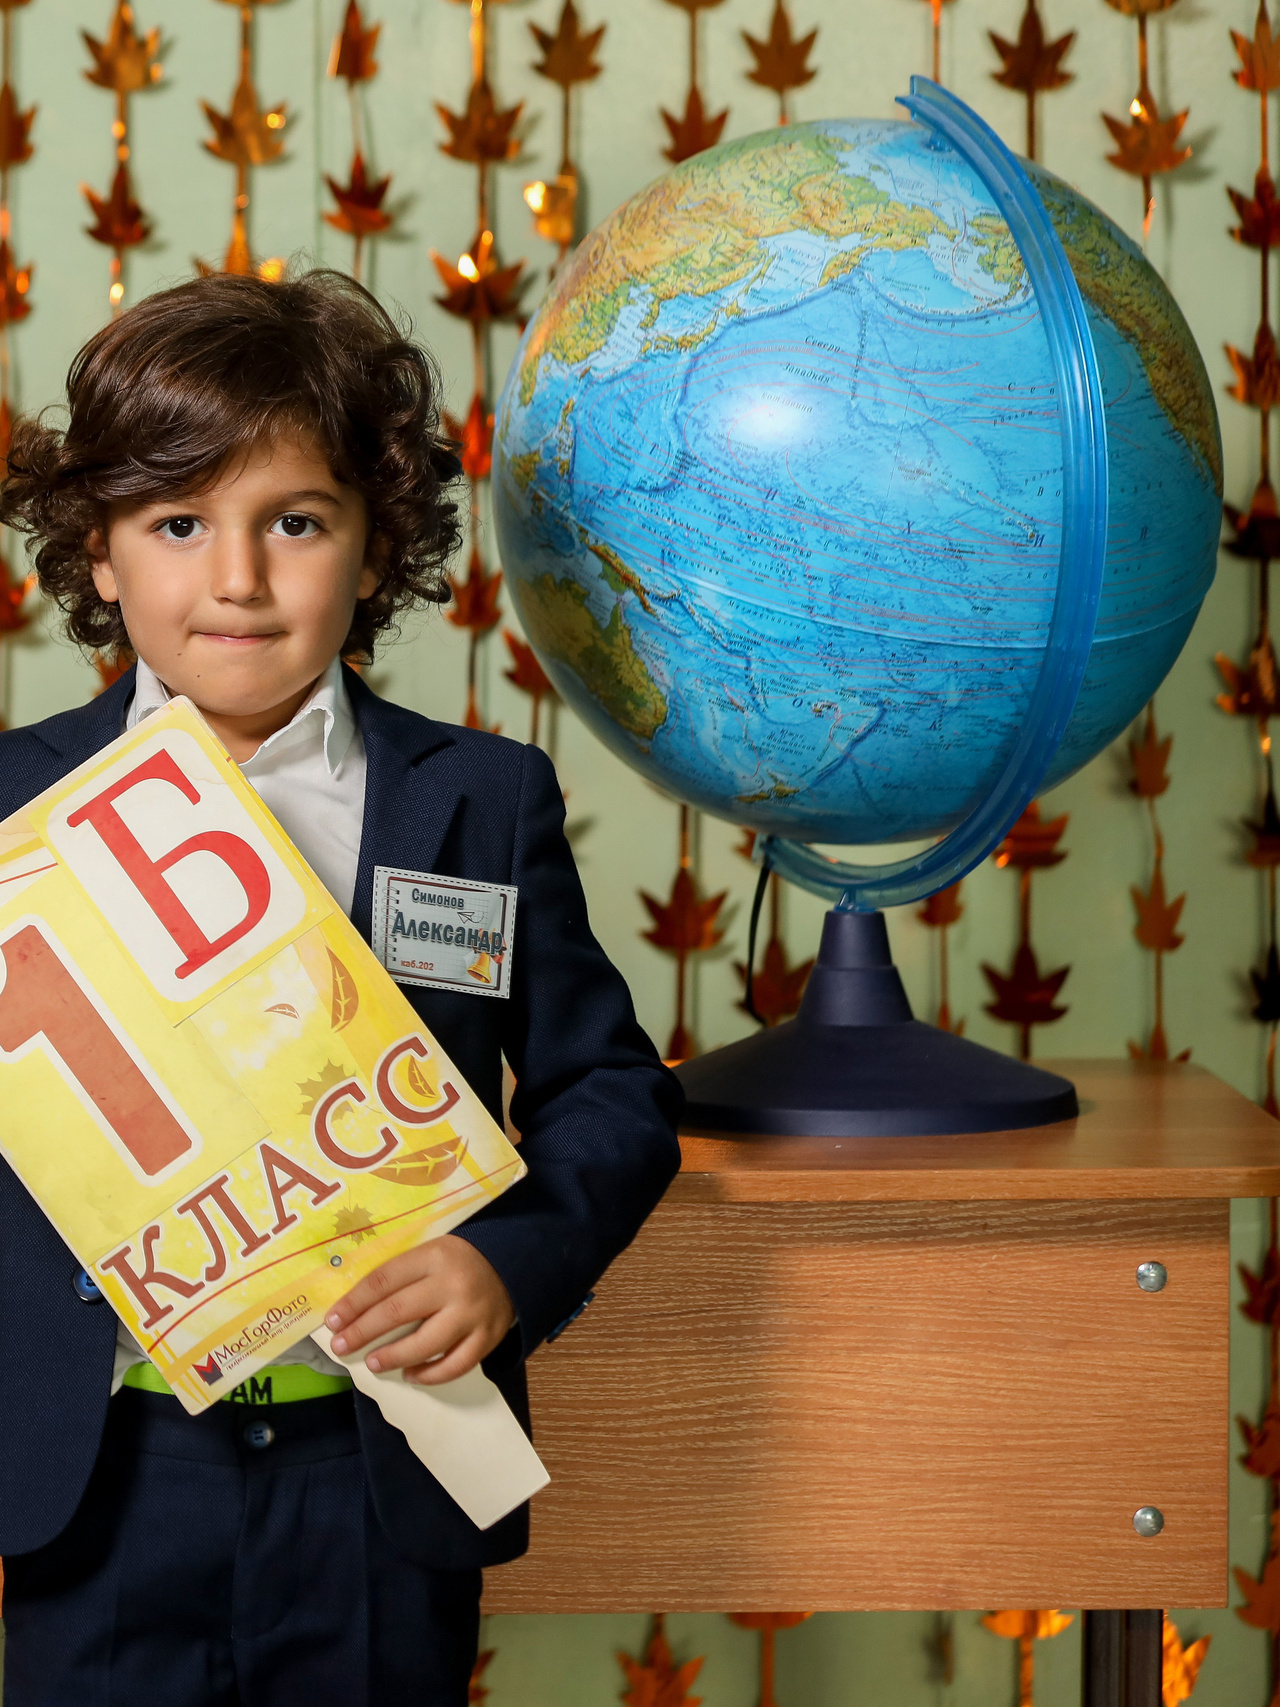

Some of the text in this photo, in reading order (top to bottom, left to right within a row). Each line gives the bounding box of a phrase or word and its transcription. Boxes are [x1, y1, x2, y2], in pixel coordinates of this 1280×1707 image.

[66, 748, 272, 980] Б
[411, 887, 465, 909] Симонов
[391, 910, 504, 956] Александр
[400, 958, 435, 971] каб.202
[100, 1036, 461, 1331] КЛАСС
[213, 1294, 308, 1364] МосГорФото
